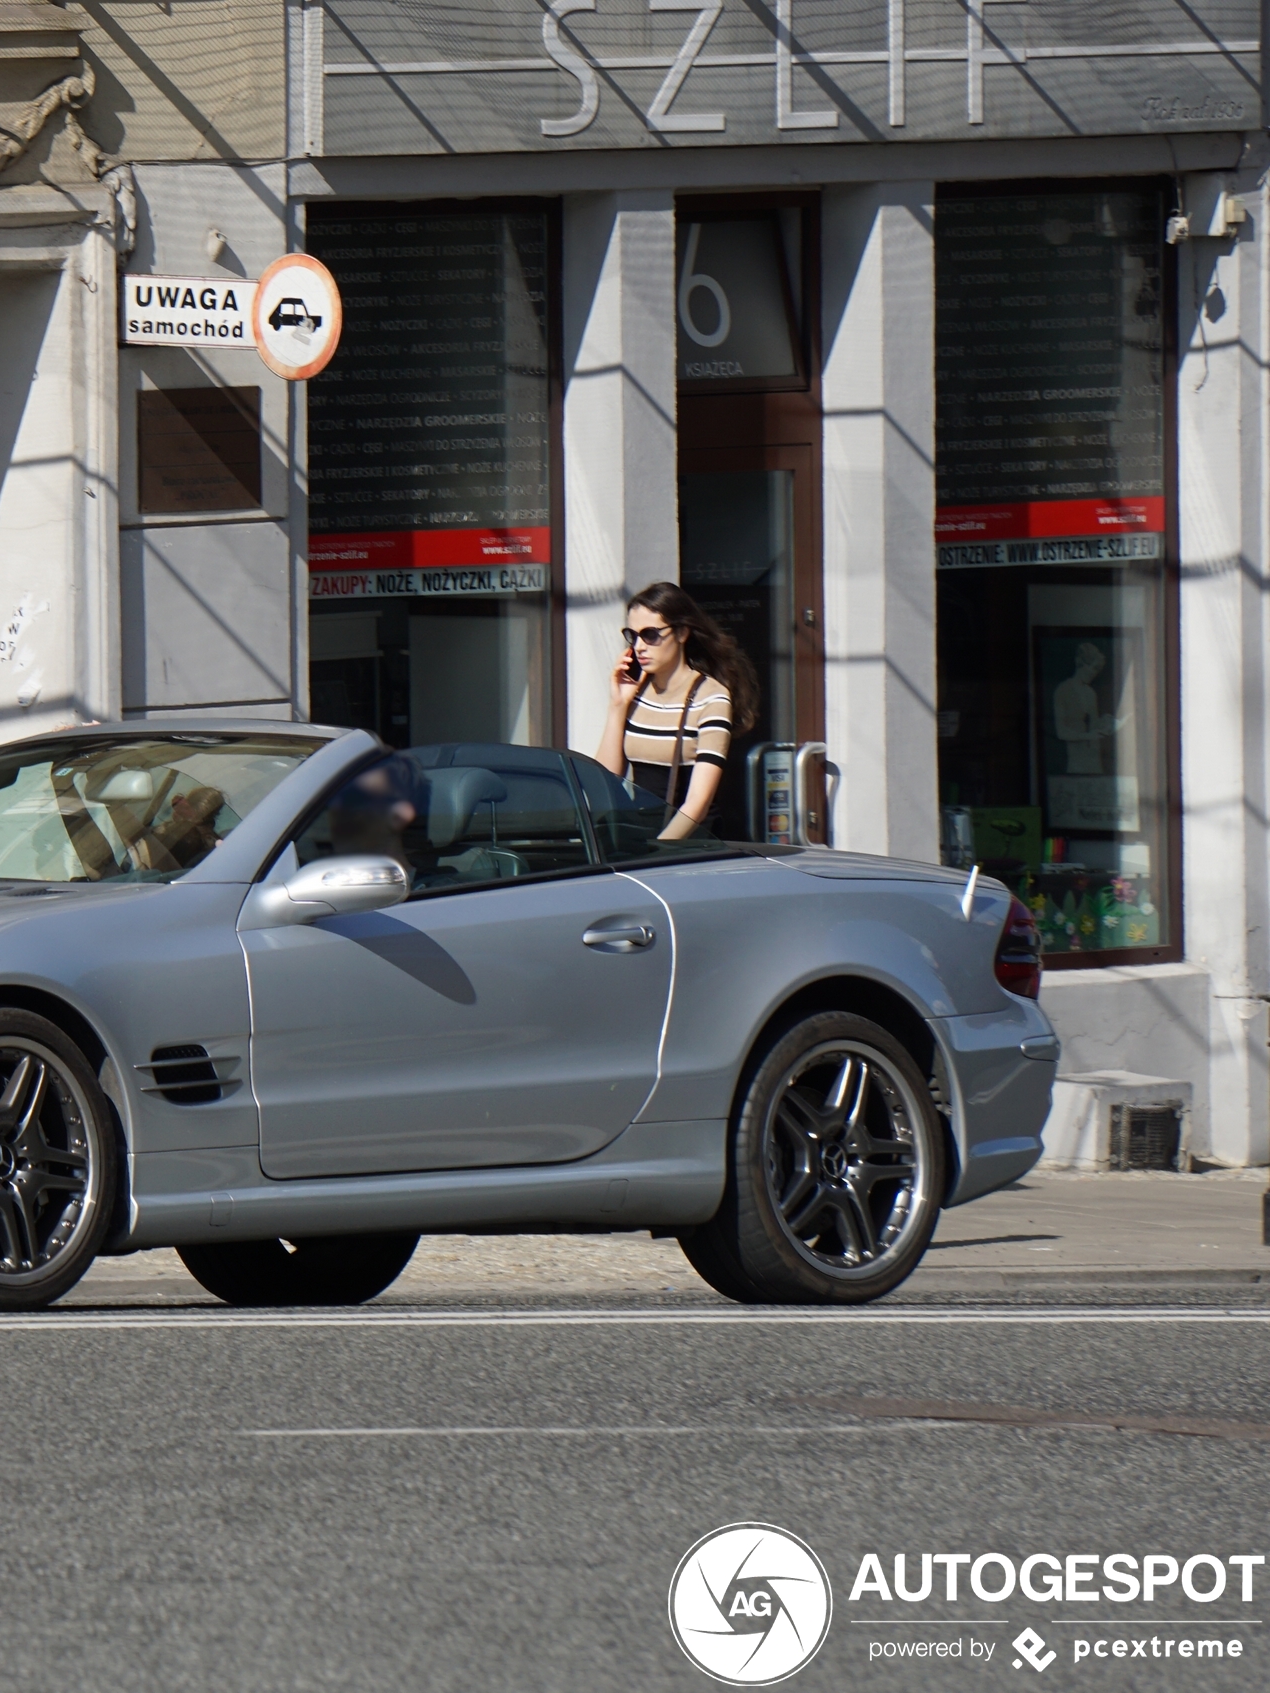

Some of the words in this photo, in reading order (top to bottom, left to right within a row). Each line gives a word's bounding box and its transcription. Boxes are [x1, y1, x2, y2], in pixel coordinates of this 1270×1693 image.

[678, 223, 730, 347] 6
[135, 285, 239, 312] UWAGA
[128, 318, 244, 339] samochód
[1042, 386, 1121, 400] GROOMERSKIE
[424, 413, 506, 427] GROOMERSKIE
[376, 570, 418, 595] NOŻE,
[422, 568, 496, 592] NOŻYCZKI,
